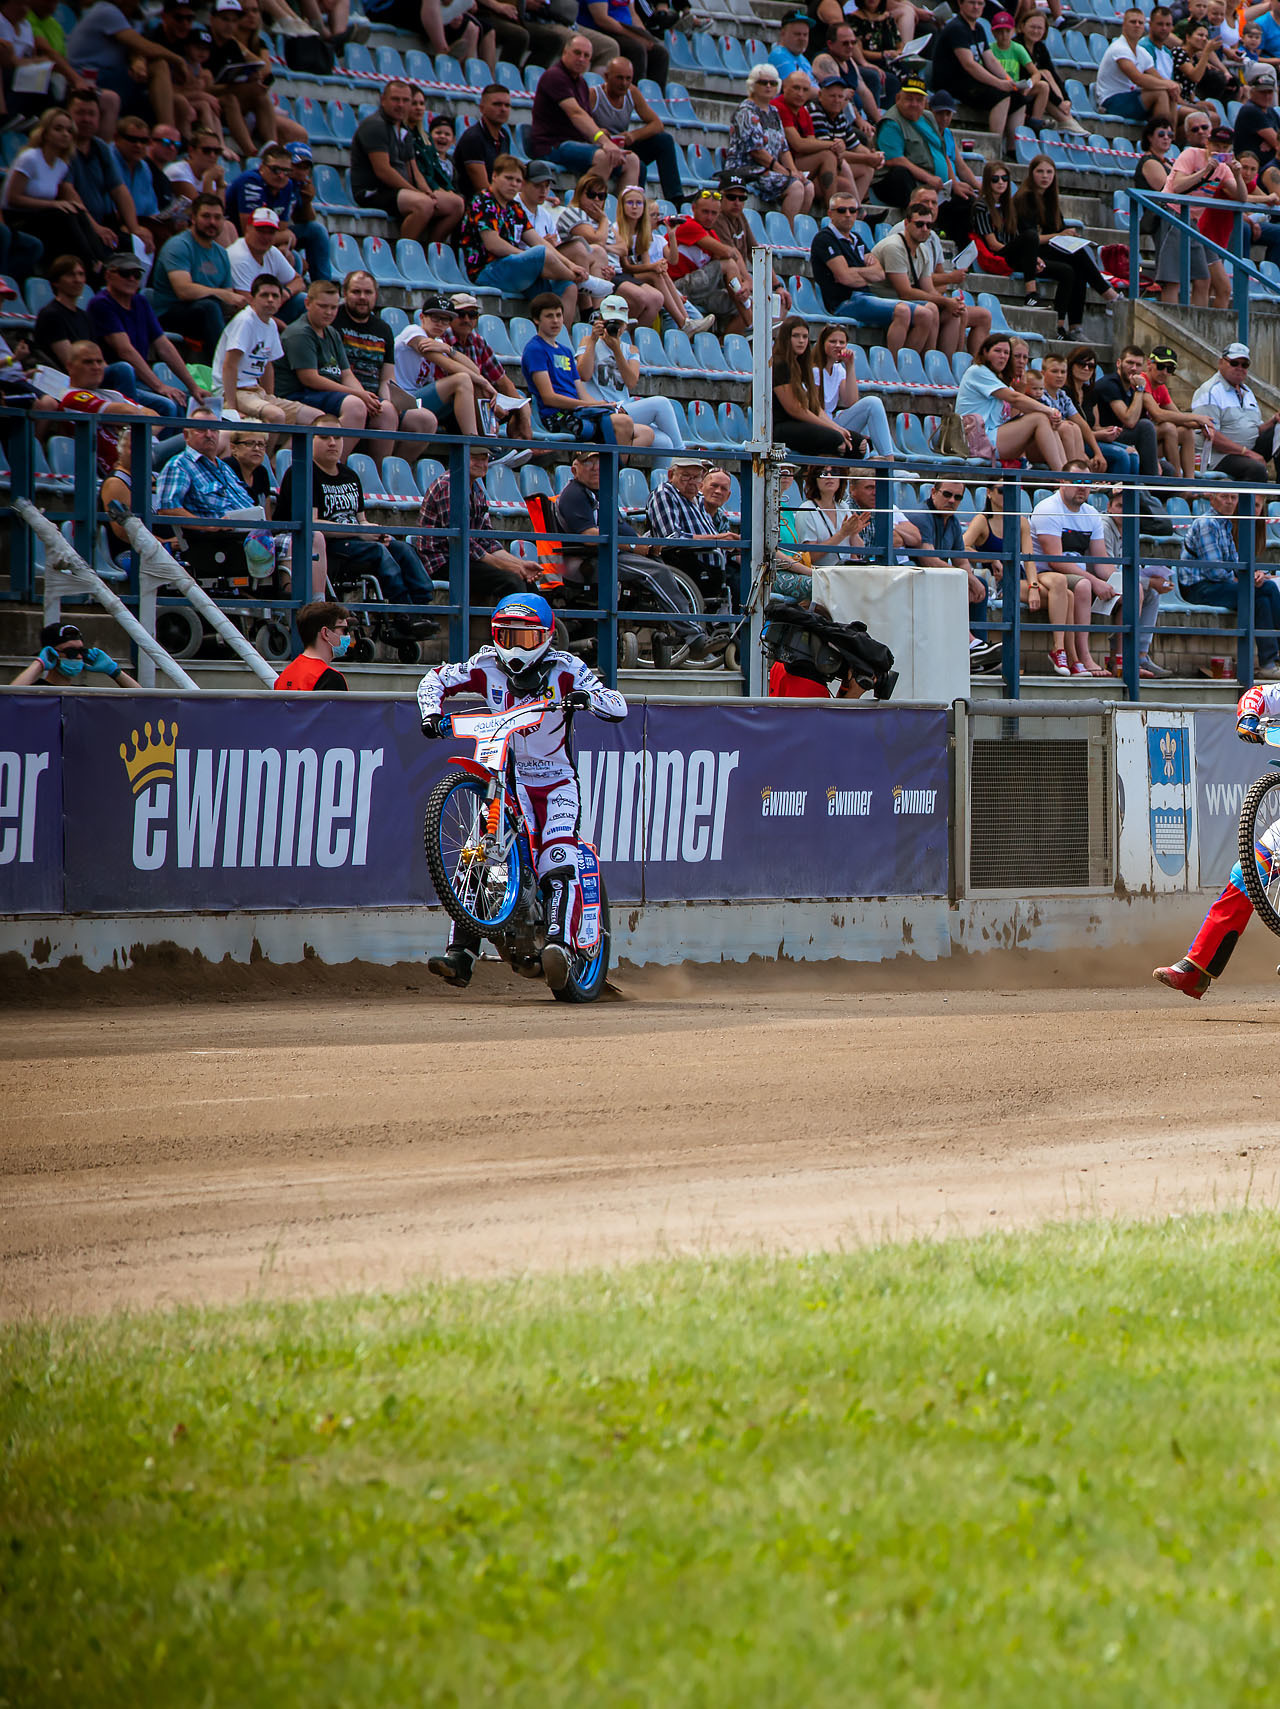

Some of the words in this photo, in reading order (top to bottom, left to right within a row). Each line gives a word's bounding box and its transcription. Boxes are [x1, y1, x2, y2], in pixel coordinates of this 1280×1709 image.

[132, 747, 384, 871] ewinner
[762, 790, 807, 816] ewinner
[827, 790, 873, 816] ewinner
[893, 789, 937, 815] ewinner
